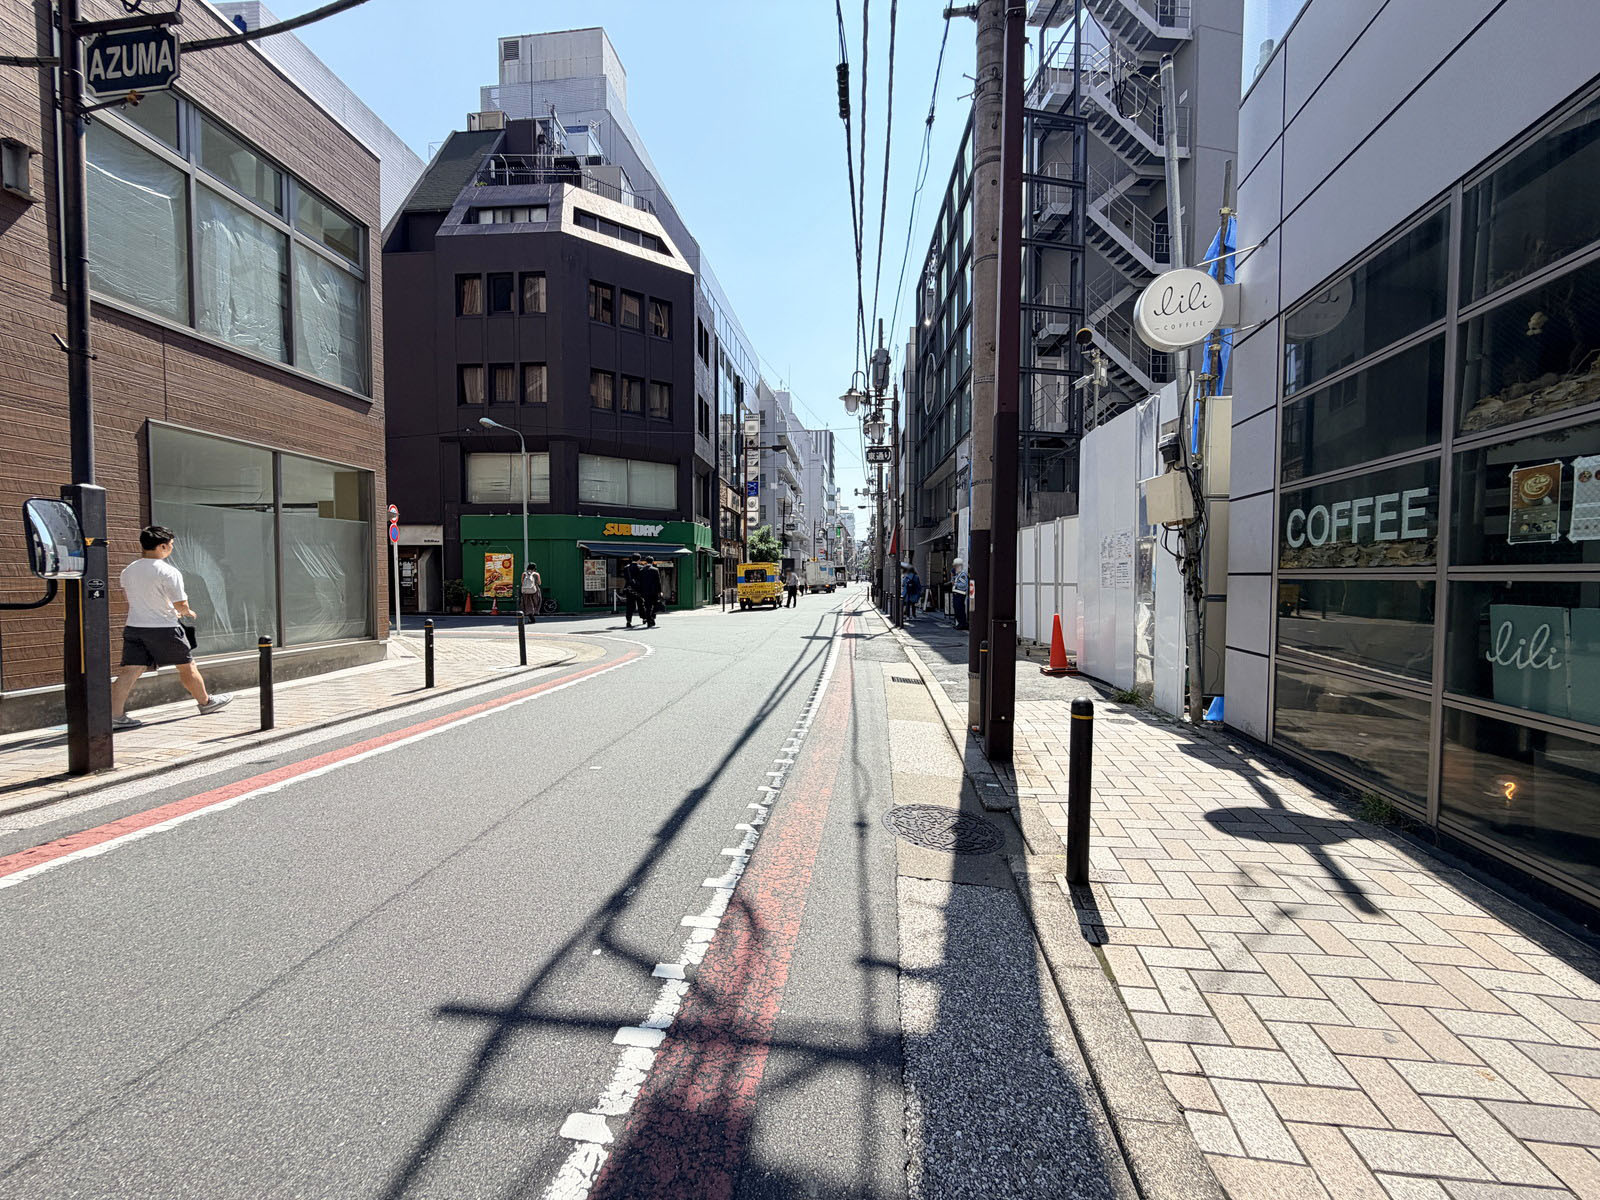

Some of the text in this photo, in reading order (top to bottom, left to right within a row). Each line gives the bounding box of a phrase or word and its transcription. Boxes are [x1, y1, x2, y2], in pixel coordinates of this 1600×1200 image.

[89, 38, 174, 81] AZUMA
[1153, 282, 1212, 317] lili
[1163, 319, 1204, 331] COFFEE
[867, 451, 891, 461] 東通り
[602, 523, 664, 537] SUBWAY
[1286, 487, 1430, 548] COFFEE
[1485, 620, 1562, 671] lili
